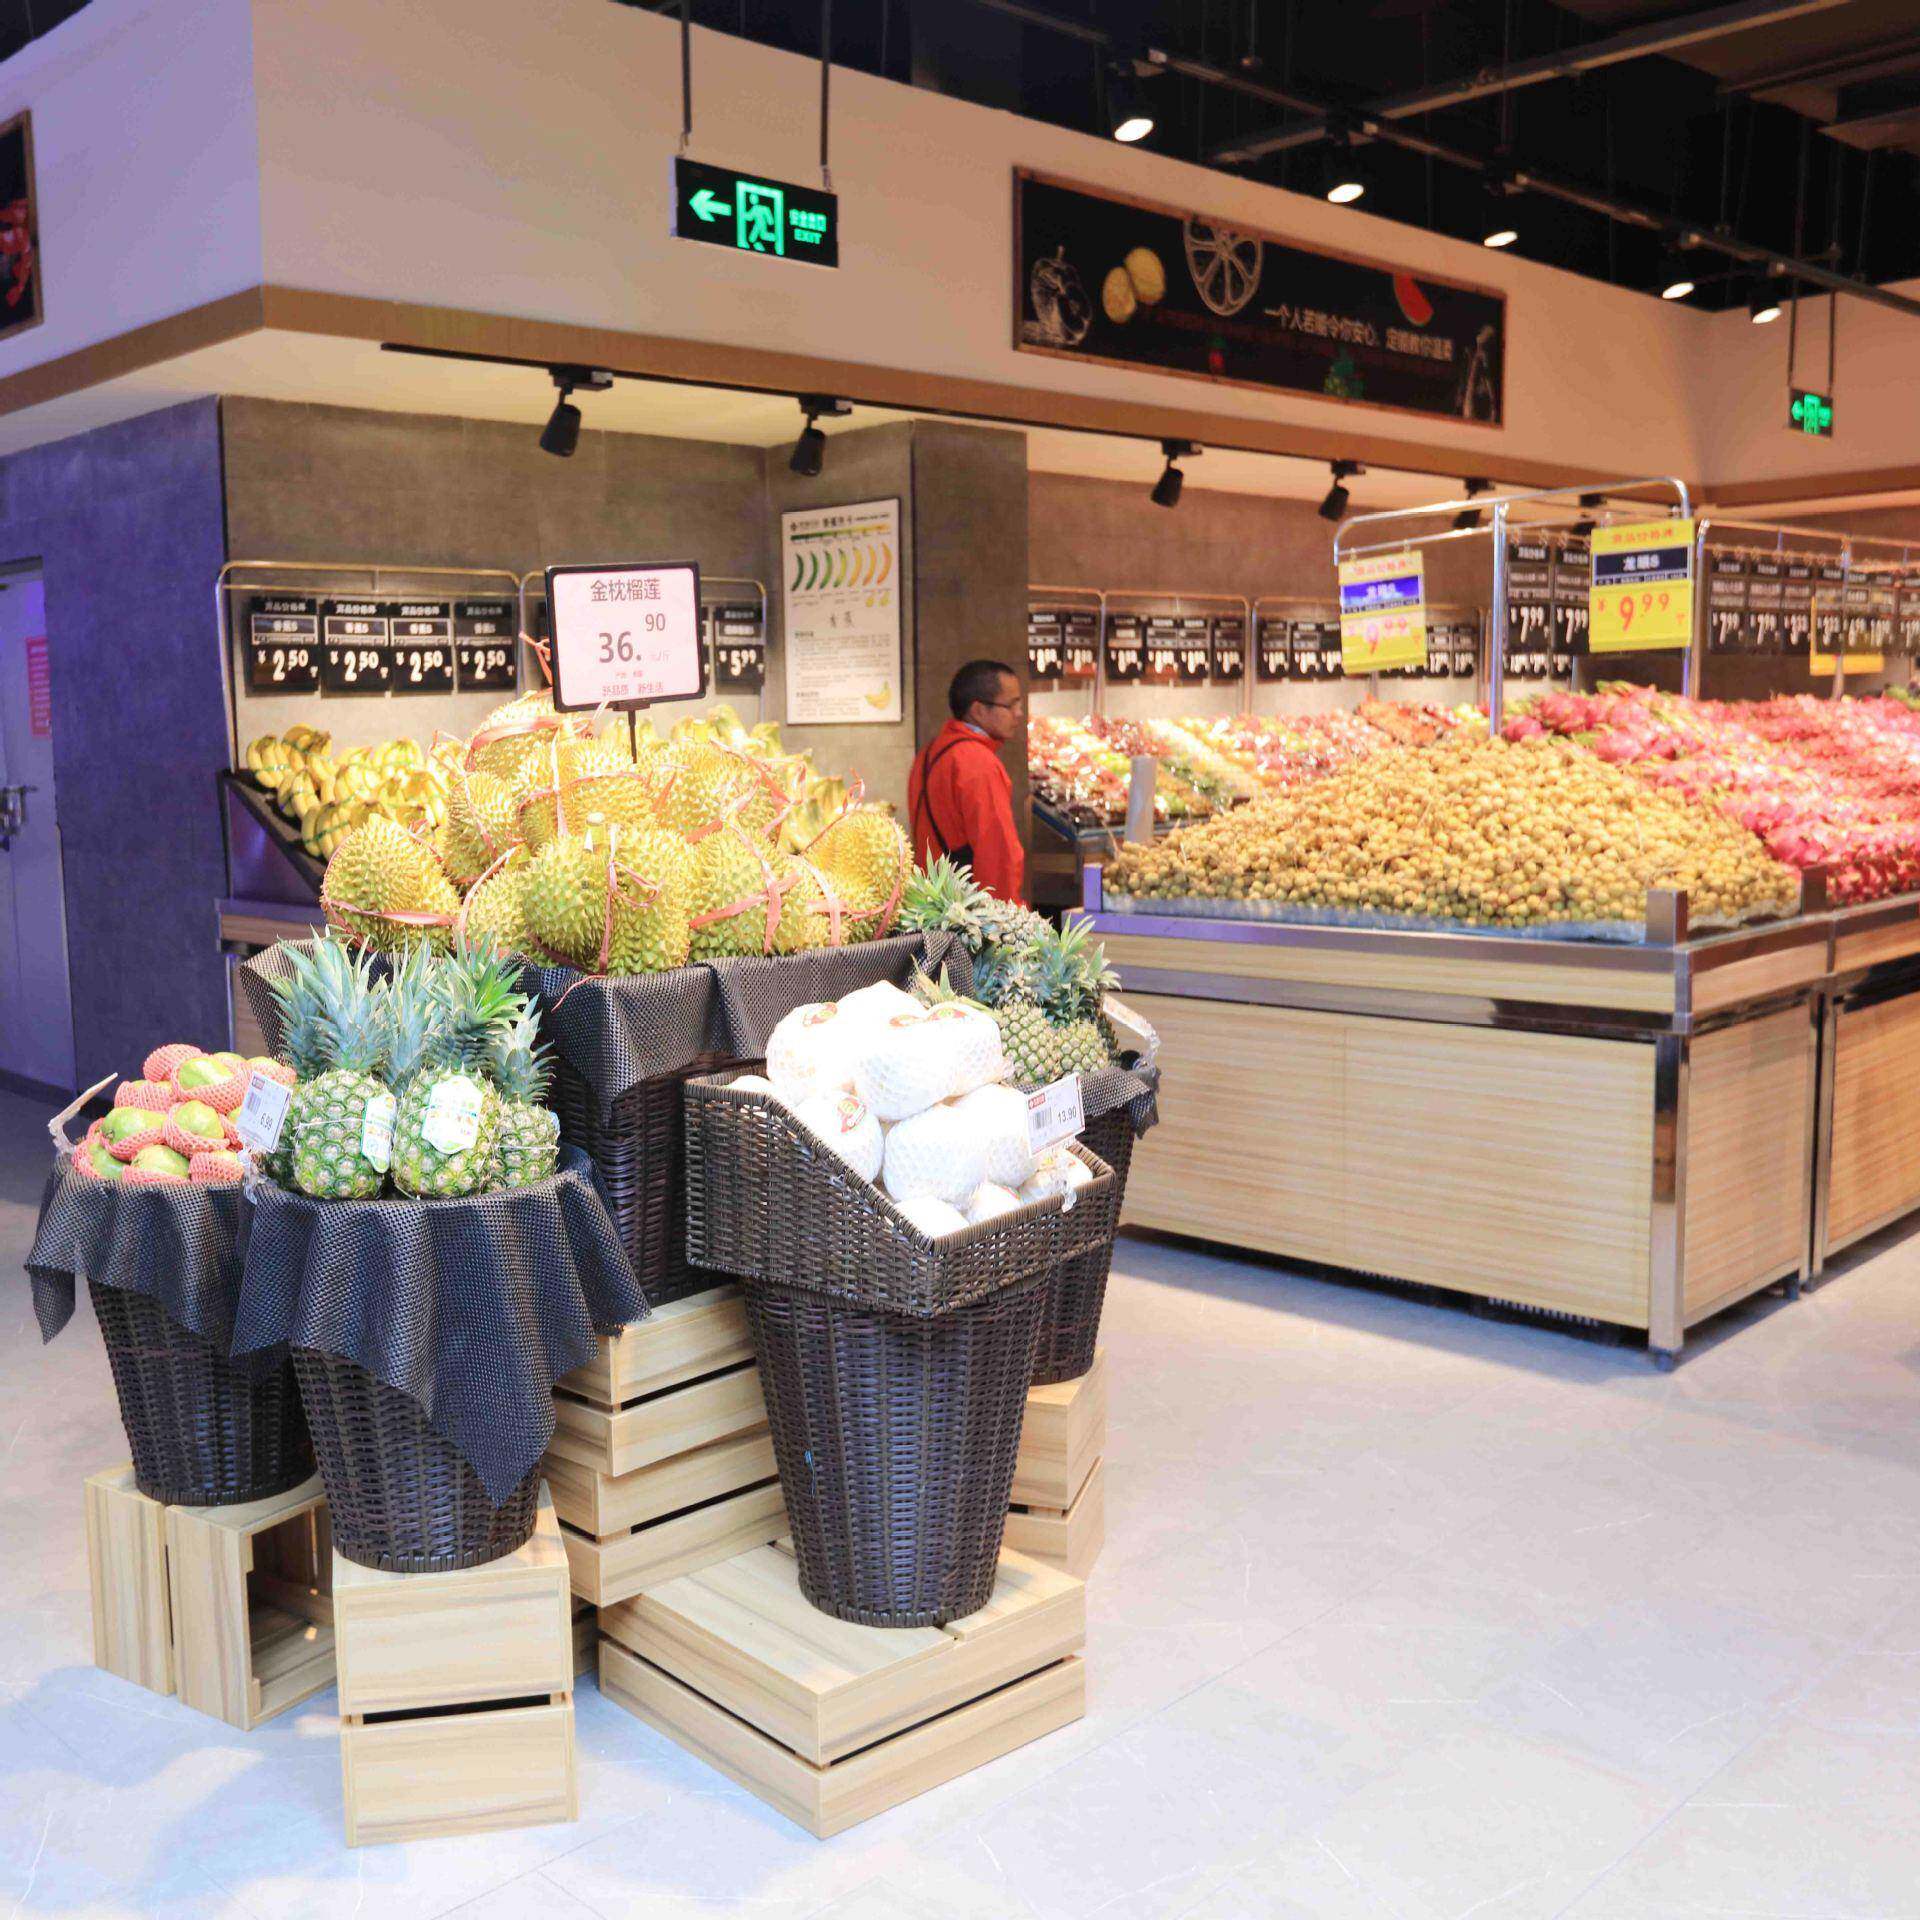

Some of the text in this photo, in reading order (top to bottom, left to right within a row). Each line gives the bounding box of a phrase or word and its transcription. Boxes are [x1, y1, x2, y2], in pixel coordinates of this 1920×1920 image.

[794, 228, 822, 245] EXIT
[590, 578, 661, 602] 金枕榴莲
[260, 1112, 273, 1130] 6.99
[1057, 1106, 1077, 1124] 13.90
